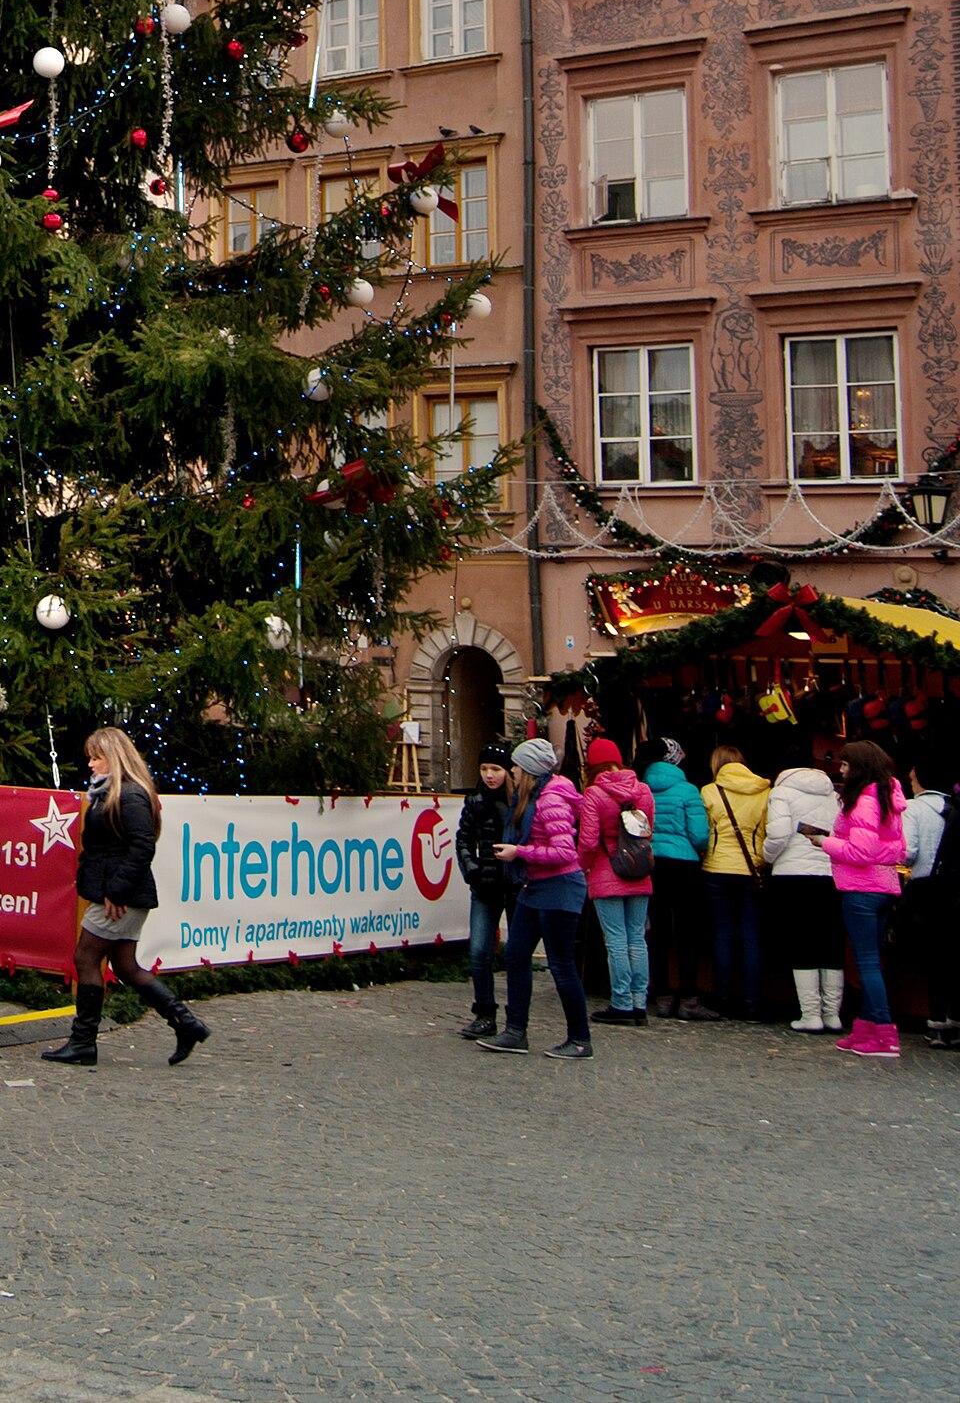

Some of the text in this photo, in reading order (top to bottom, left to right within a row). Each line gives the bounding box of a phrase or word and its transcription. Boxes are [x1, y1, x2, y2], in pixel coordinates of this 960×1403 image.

[653, 599, 718, 610] U BARSSA
[669, 586, 702, 596] 1853
[181, 821, 404, 902] Interhome
[181, 907, 420, 952] Domy i apartamenty wakacyjne
